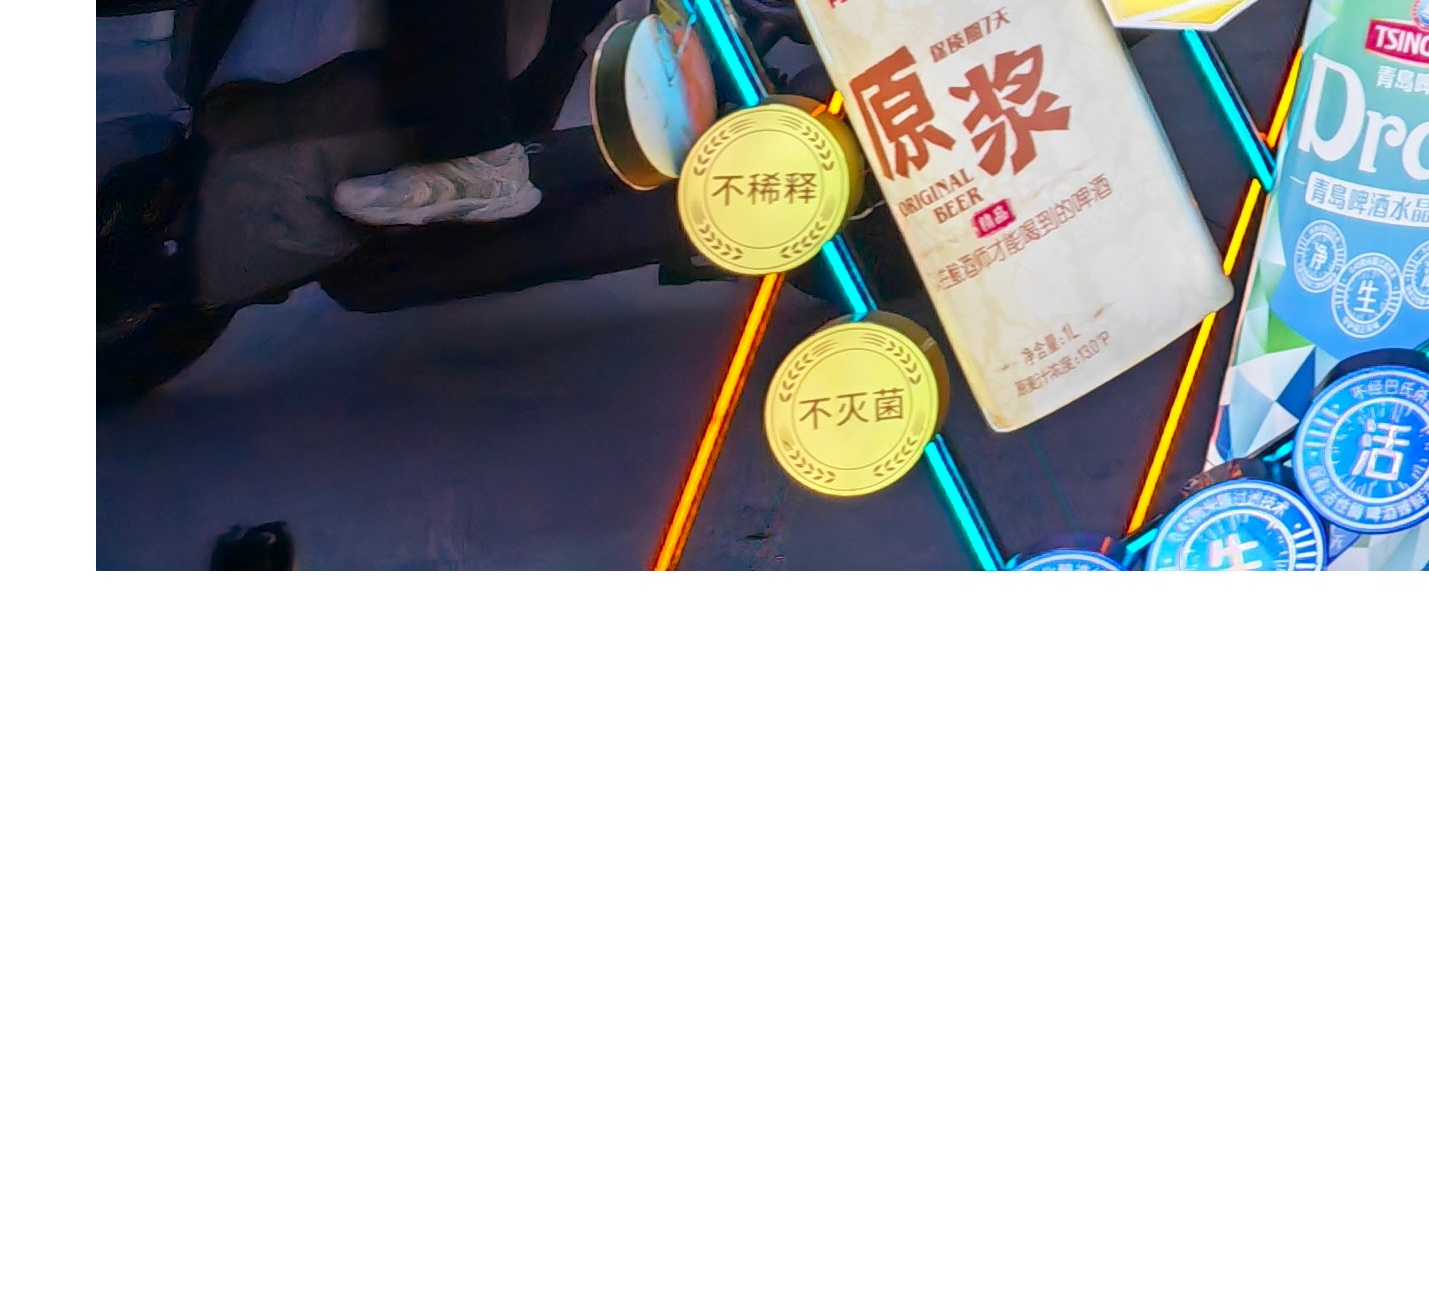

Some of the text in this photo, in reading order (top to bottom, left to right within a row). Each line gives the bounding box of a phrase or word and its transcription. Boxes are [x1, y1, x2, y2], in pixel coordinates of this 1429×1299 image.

[849, 43, 1074, 182] 原浆
[710, 171, 819, 207] 不稀释
[897, 167, 975, 218] ORIGINAL
[931, 187, 985, 225] BEER
[1353, 279, 1380, 314] 生
[798, 386, 907, 432] 不灭菌
[1349, 418, 1413, 483] 活
